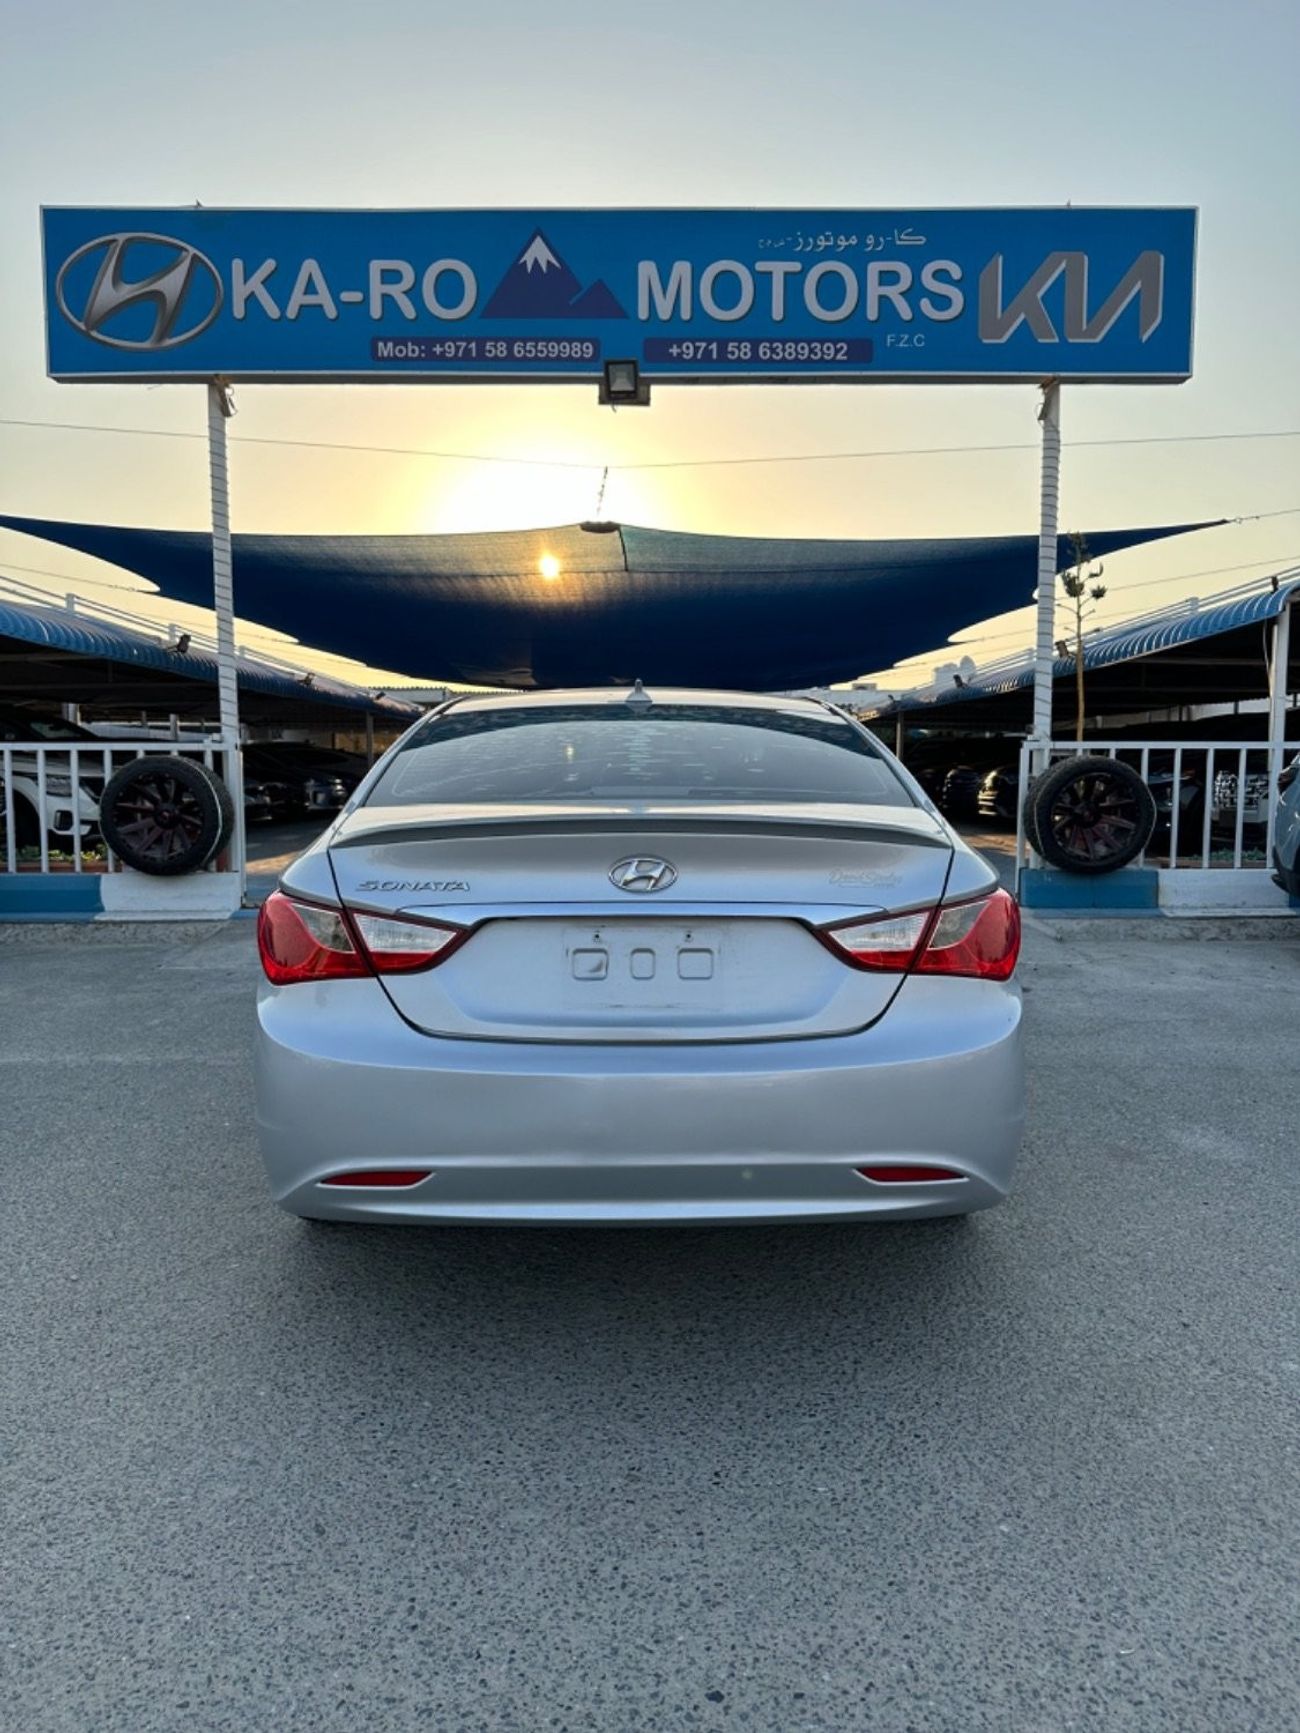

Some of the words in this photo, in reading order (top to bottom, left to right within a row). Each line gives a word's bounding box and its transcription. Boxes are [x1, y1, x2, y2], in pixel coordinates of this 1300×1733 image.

[230, 257, 479, 321] KA-RO
[636, 258, 965, 323] MOTORS
[377, 341, 426, 358] Mob:
[432, 341, 477, 358] +971
[484, 341, 508, 358] 58
[513, 341, 594, 358] 6559989
[668, 342, 718, 360] +971
[726, 342, 752, 360] 58
[758, 342, 848, 361] 6389392
[355, 880, 471, 892] SONATA
